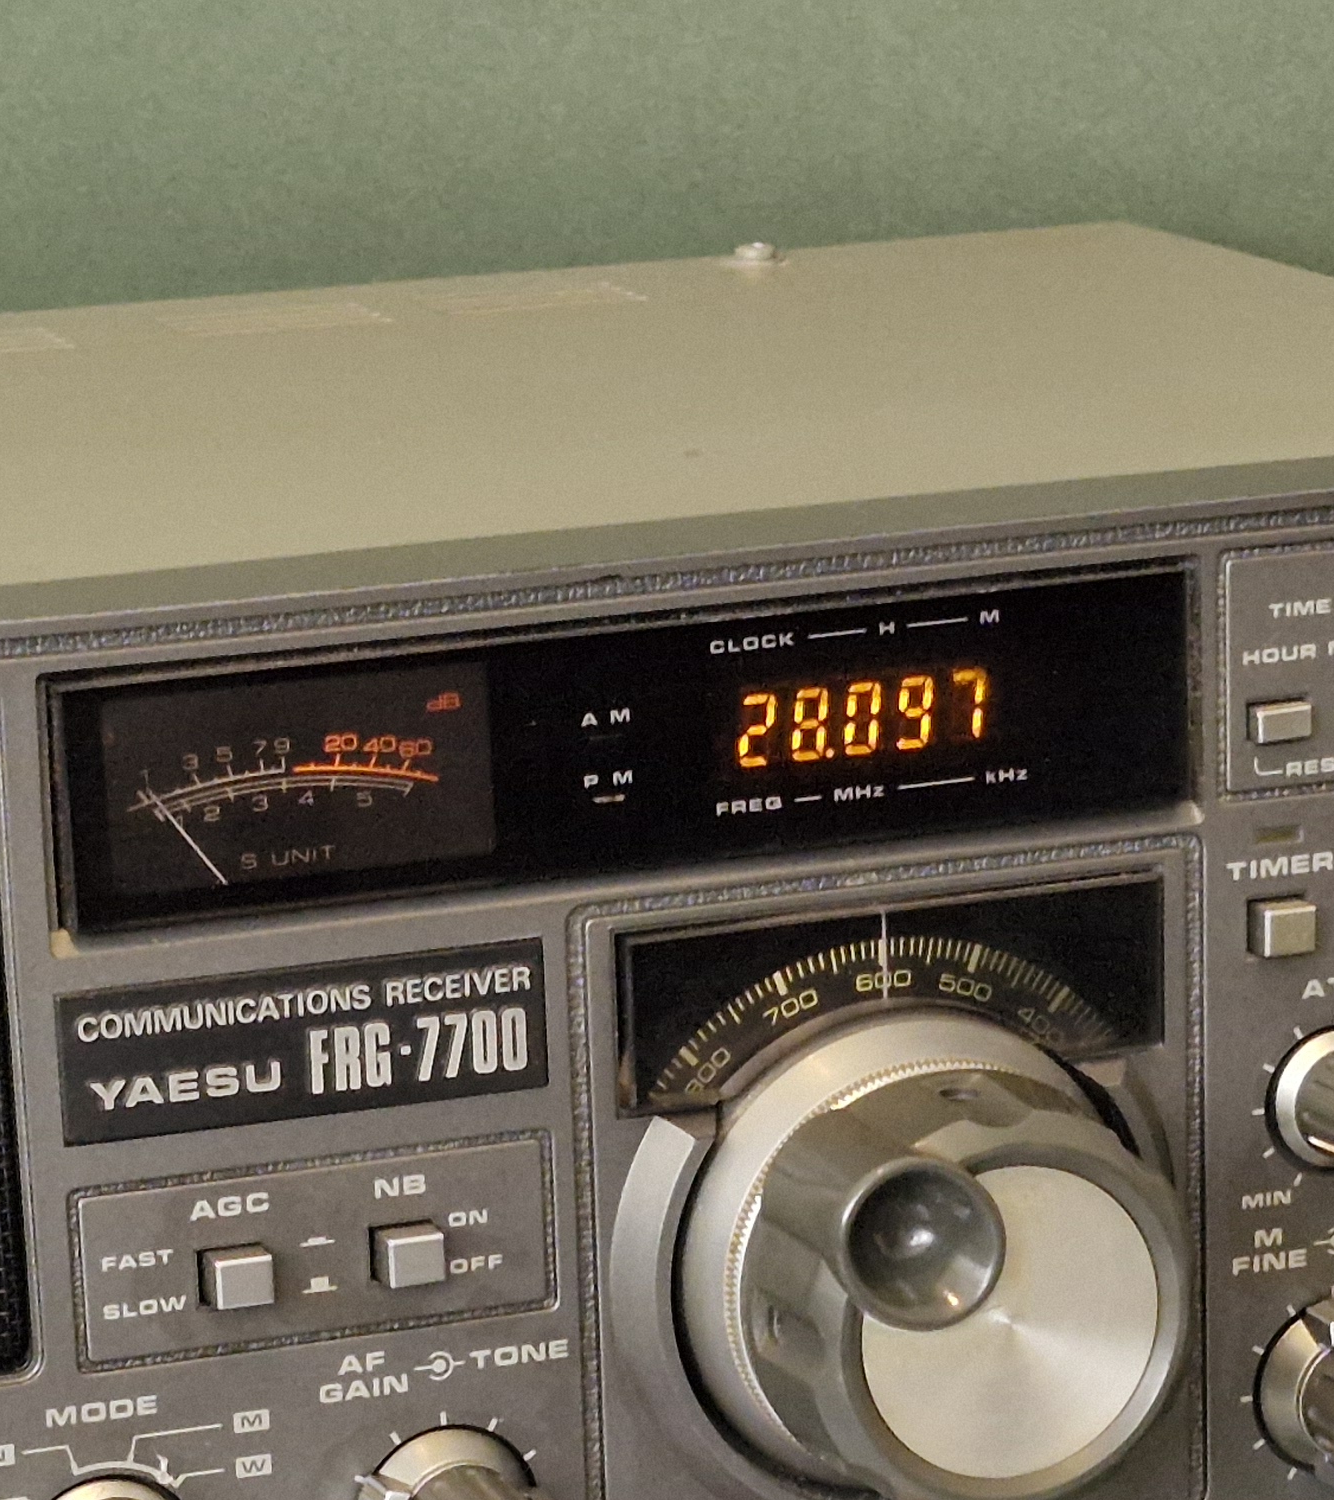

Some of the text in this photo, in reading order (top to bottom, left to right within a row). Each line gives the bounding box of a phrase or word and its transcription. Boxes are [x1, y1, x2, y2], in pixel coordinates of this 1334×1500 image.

[1269, 598, 1331, 619] TIME
[709, 609, 1001, 655] CLOCK H M
[1242, 643, 1317, 666] HOUR
[427, 692, 461, 712] dB
[737, 667, 989, 769] 28.097
[216, 746, 233, 763] 5
[251, 739, 267, 756] 7
[273, 737, 291, 754] 9
[324, 732, 359, 753] 20
[363, 734, 397, 754] 40
[398, 738, 433, 756] 60
[716, 767, 1028, 817] FREQ MHz kHz
[204, 805, 220, 822] 2
[298, 791, 315, 807] 4
[240, 845, 335, 870] S UNIT
[1226, 851, 1334, 881] TIMER
[76, 964, 532, 1044] COMMUNICATIONS RECEIVER
[763, 989, 818, 1027] 700
[855, 969, 911, 992] 600
[938, 973, 993, 1002] 500
[88, 1060, 283, 1112] YAESU
[373, 1174, 427, 1200] NB
[1241, 1189, 1291, 1210] MIN
[190, 1193, 270, 1222] AGC
[447, 1209, 489, 1228] ON
[1253, 1229, 1284, 1249] M
[101, 1249, 174, 1272] FAST
[449, 1254, 503, 1275] OFF
[1232, 1247, 1308, 1275] FINE
[102, 1296, 186, 1321] SLOW
[338, 1351, 386, 1376] AF
[469, 1340, 569, 1370] TONE
[319, 1373, 408, 1404] GAIN
[44, 1396, 158, 1428] MODE
[240, 1414, 263, 1430] M
[240, 1459, 267, 1476] W
